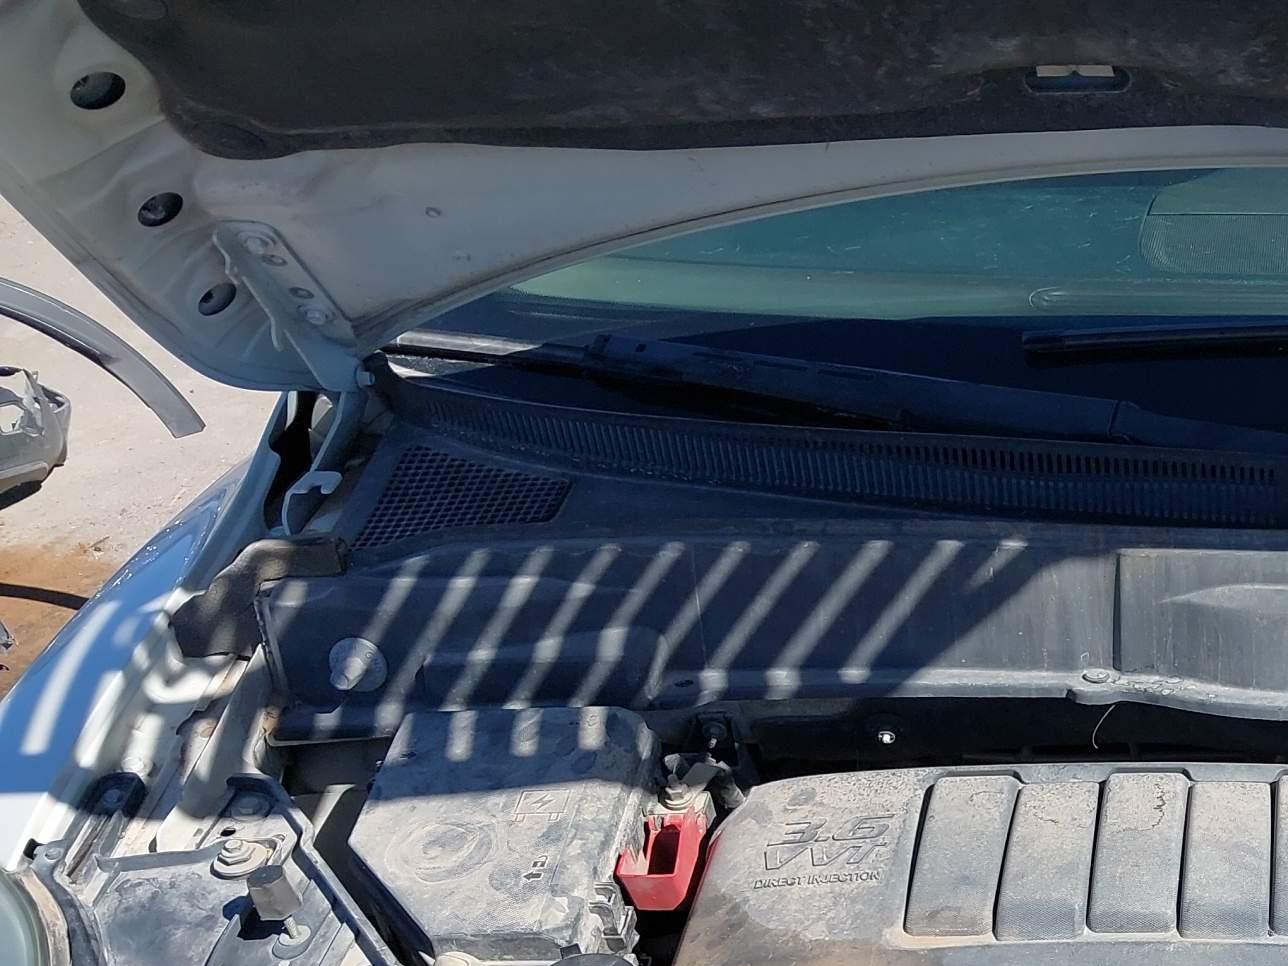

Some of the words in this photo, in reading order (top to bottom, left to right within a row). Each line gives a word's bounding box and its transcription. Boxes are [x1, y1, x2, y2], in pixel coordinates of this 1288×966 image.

[766, 812, 896, 847] 3.6
[763, 841, 889, 872] VVT
[752, 875, 806, 890] DIRECT
[806, 870, 882, 886] INJECTION
